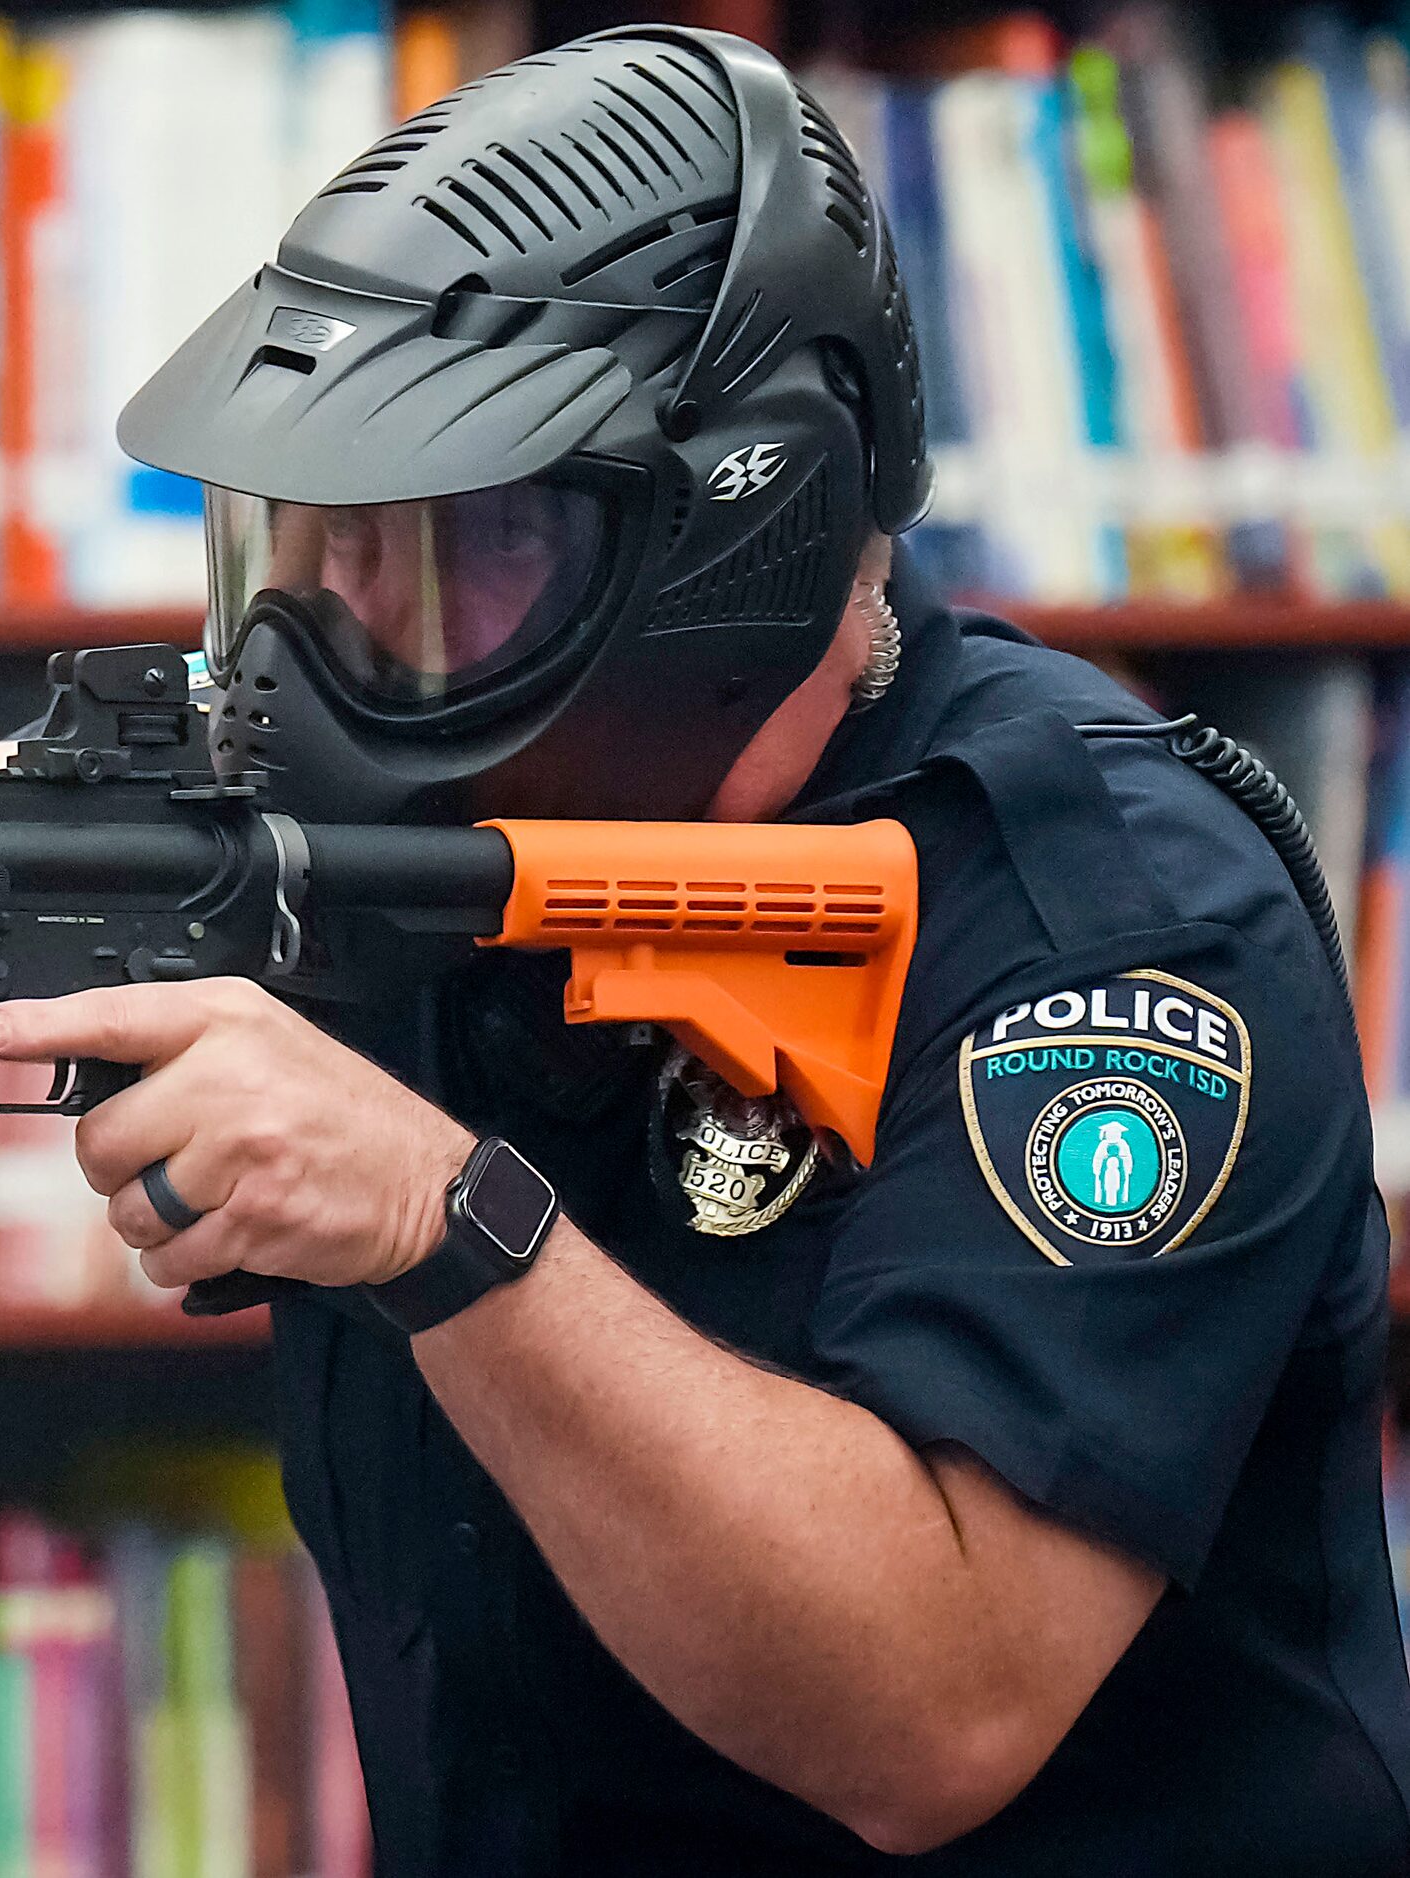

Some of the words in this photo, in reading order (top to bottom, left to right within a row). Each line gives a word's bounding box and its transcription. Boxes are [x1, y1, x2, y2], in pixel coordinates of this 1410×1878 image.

[992, 988, 1228, 1060] POLICE
[986, 1048, 1095, 1080] ROUND
[1105, 1048, 1181, 1083] ROCK
[1188, 1065, 1228, 1101] ISD
[1032, 1102, 1069, 1212] PROTECTING
[1067, 1083, 1177, 1141] TOMORROW'S
[1149, 1147, 1182, 1221] LEADERS
[1089, 1220, 1134, 1240] 1913
